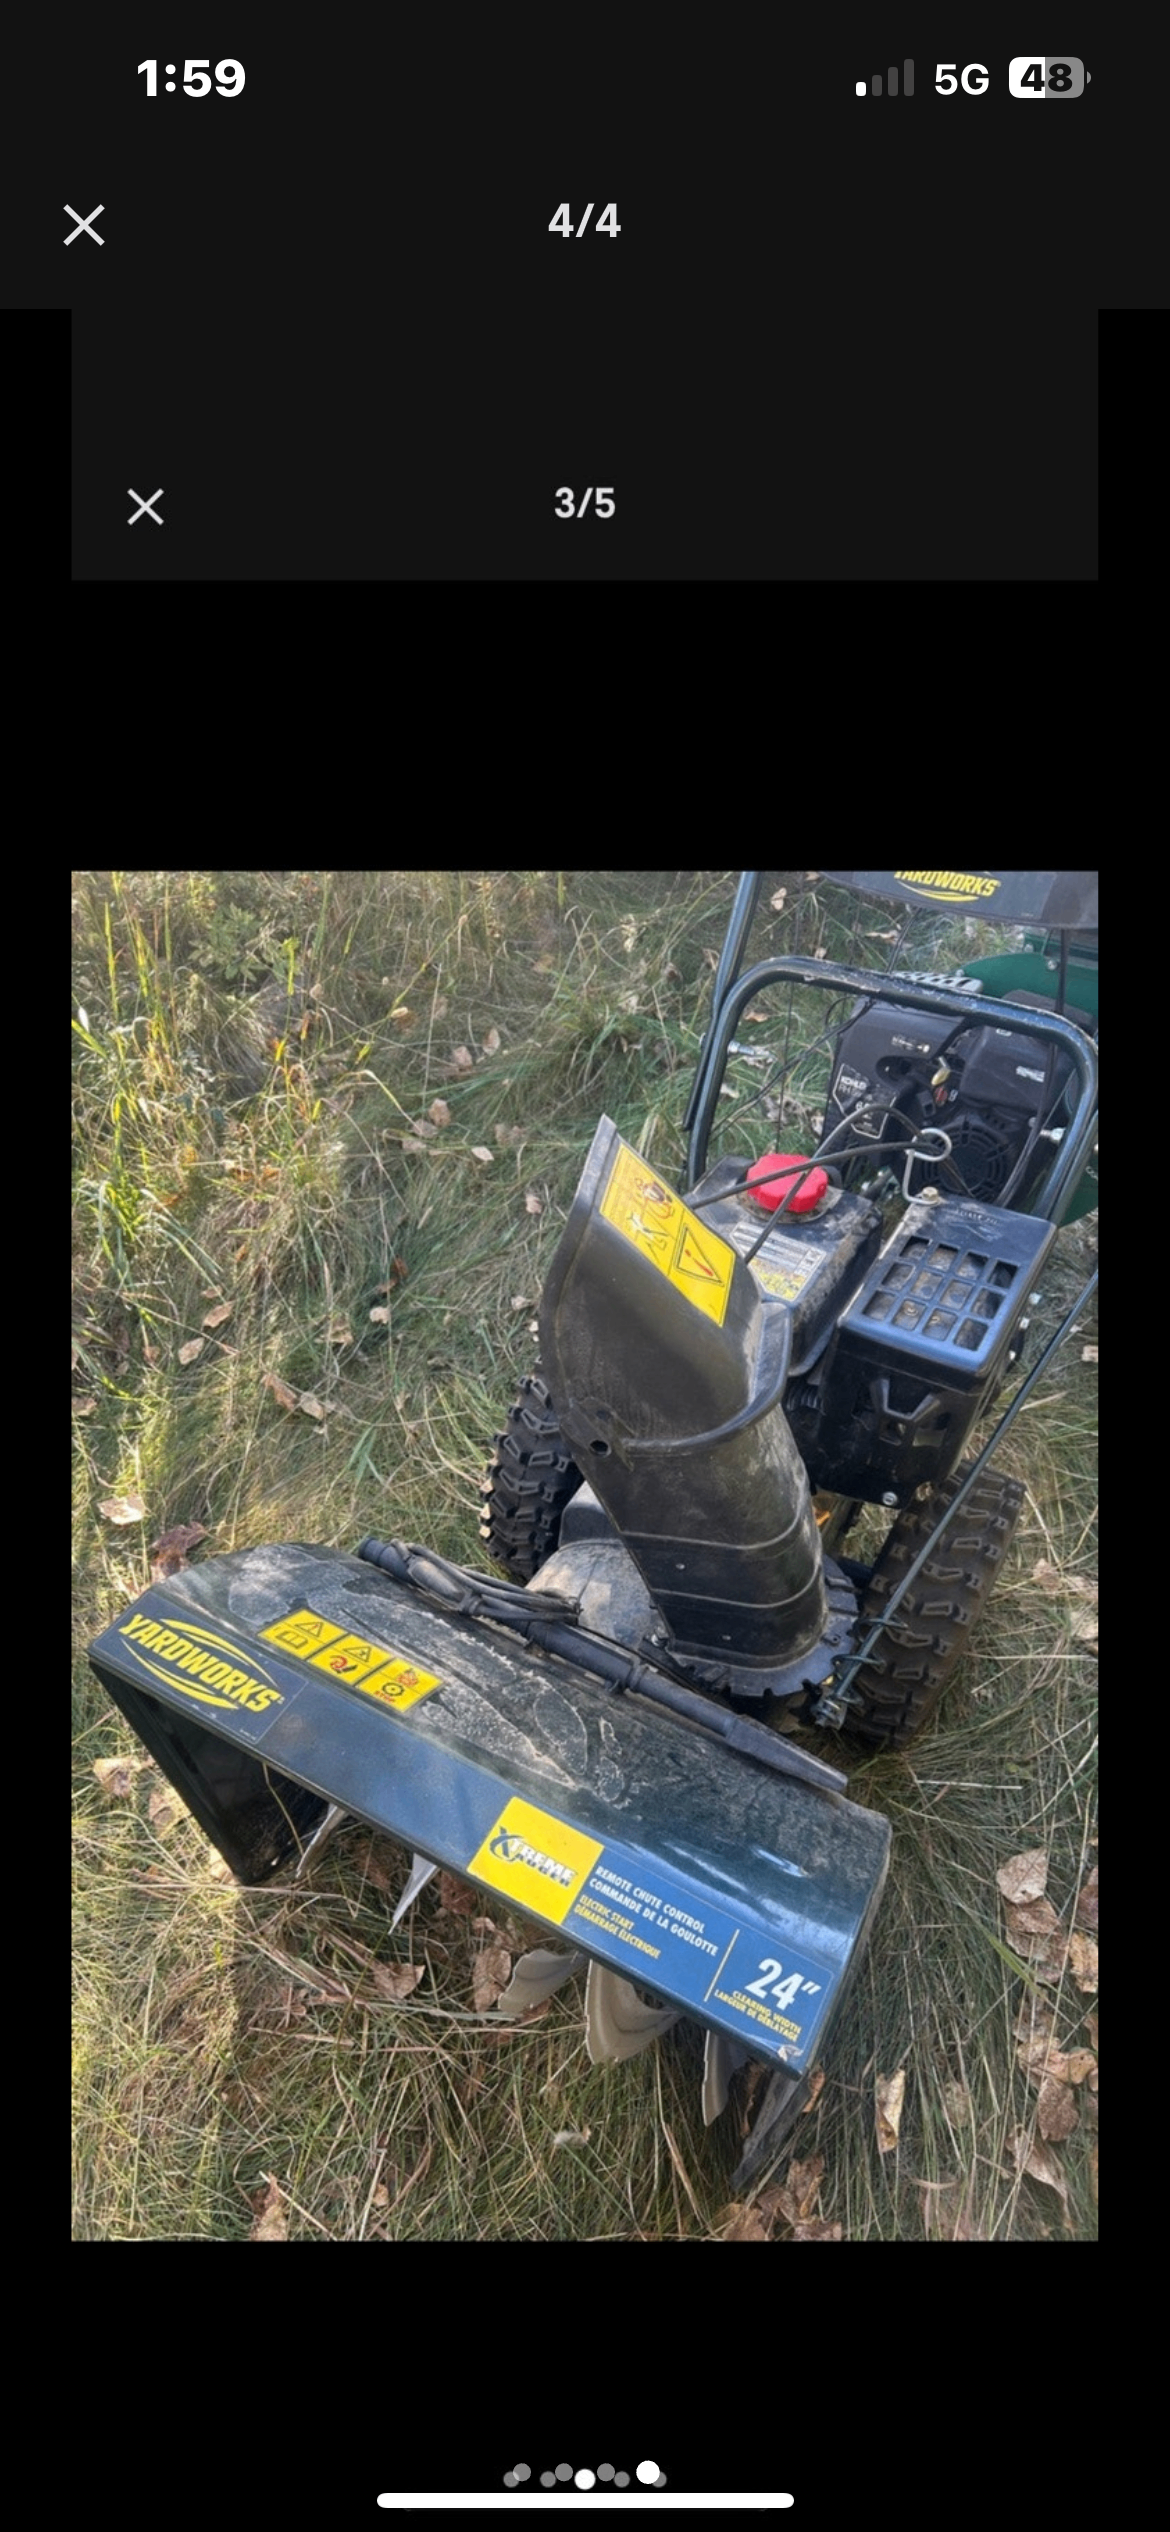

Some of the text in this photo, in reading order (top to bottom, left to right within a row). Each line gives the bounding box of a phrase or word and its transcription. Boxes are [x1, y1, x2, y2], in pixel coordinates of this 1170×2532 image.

[118, 1613, 283, 1713] YARDWORKS
[579, 1894, 635, 1931] ELECTRIC START
[589, 1878, 719, 1957] COMMANDE DE LA GOULOTTE
[595, 1865, 705, 1934] REMOTE CHUTE CONTROL
